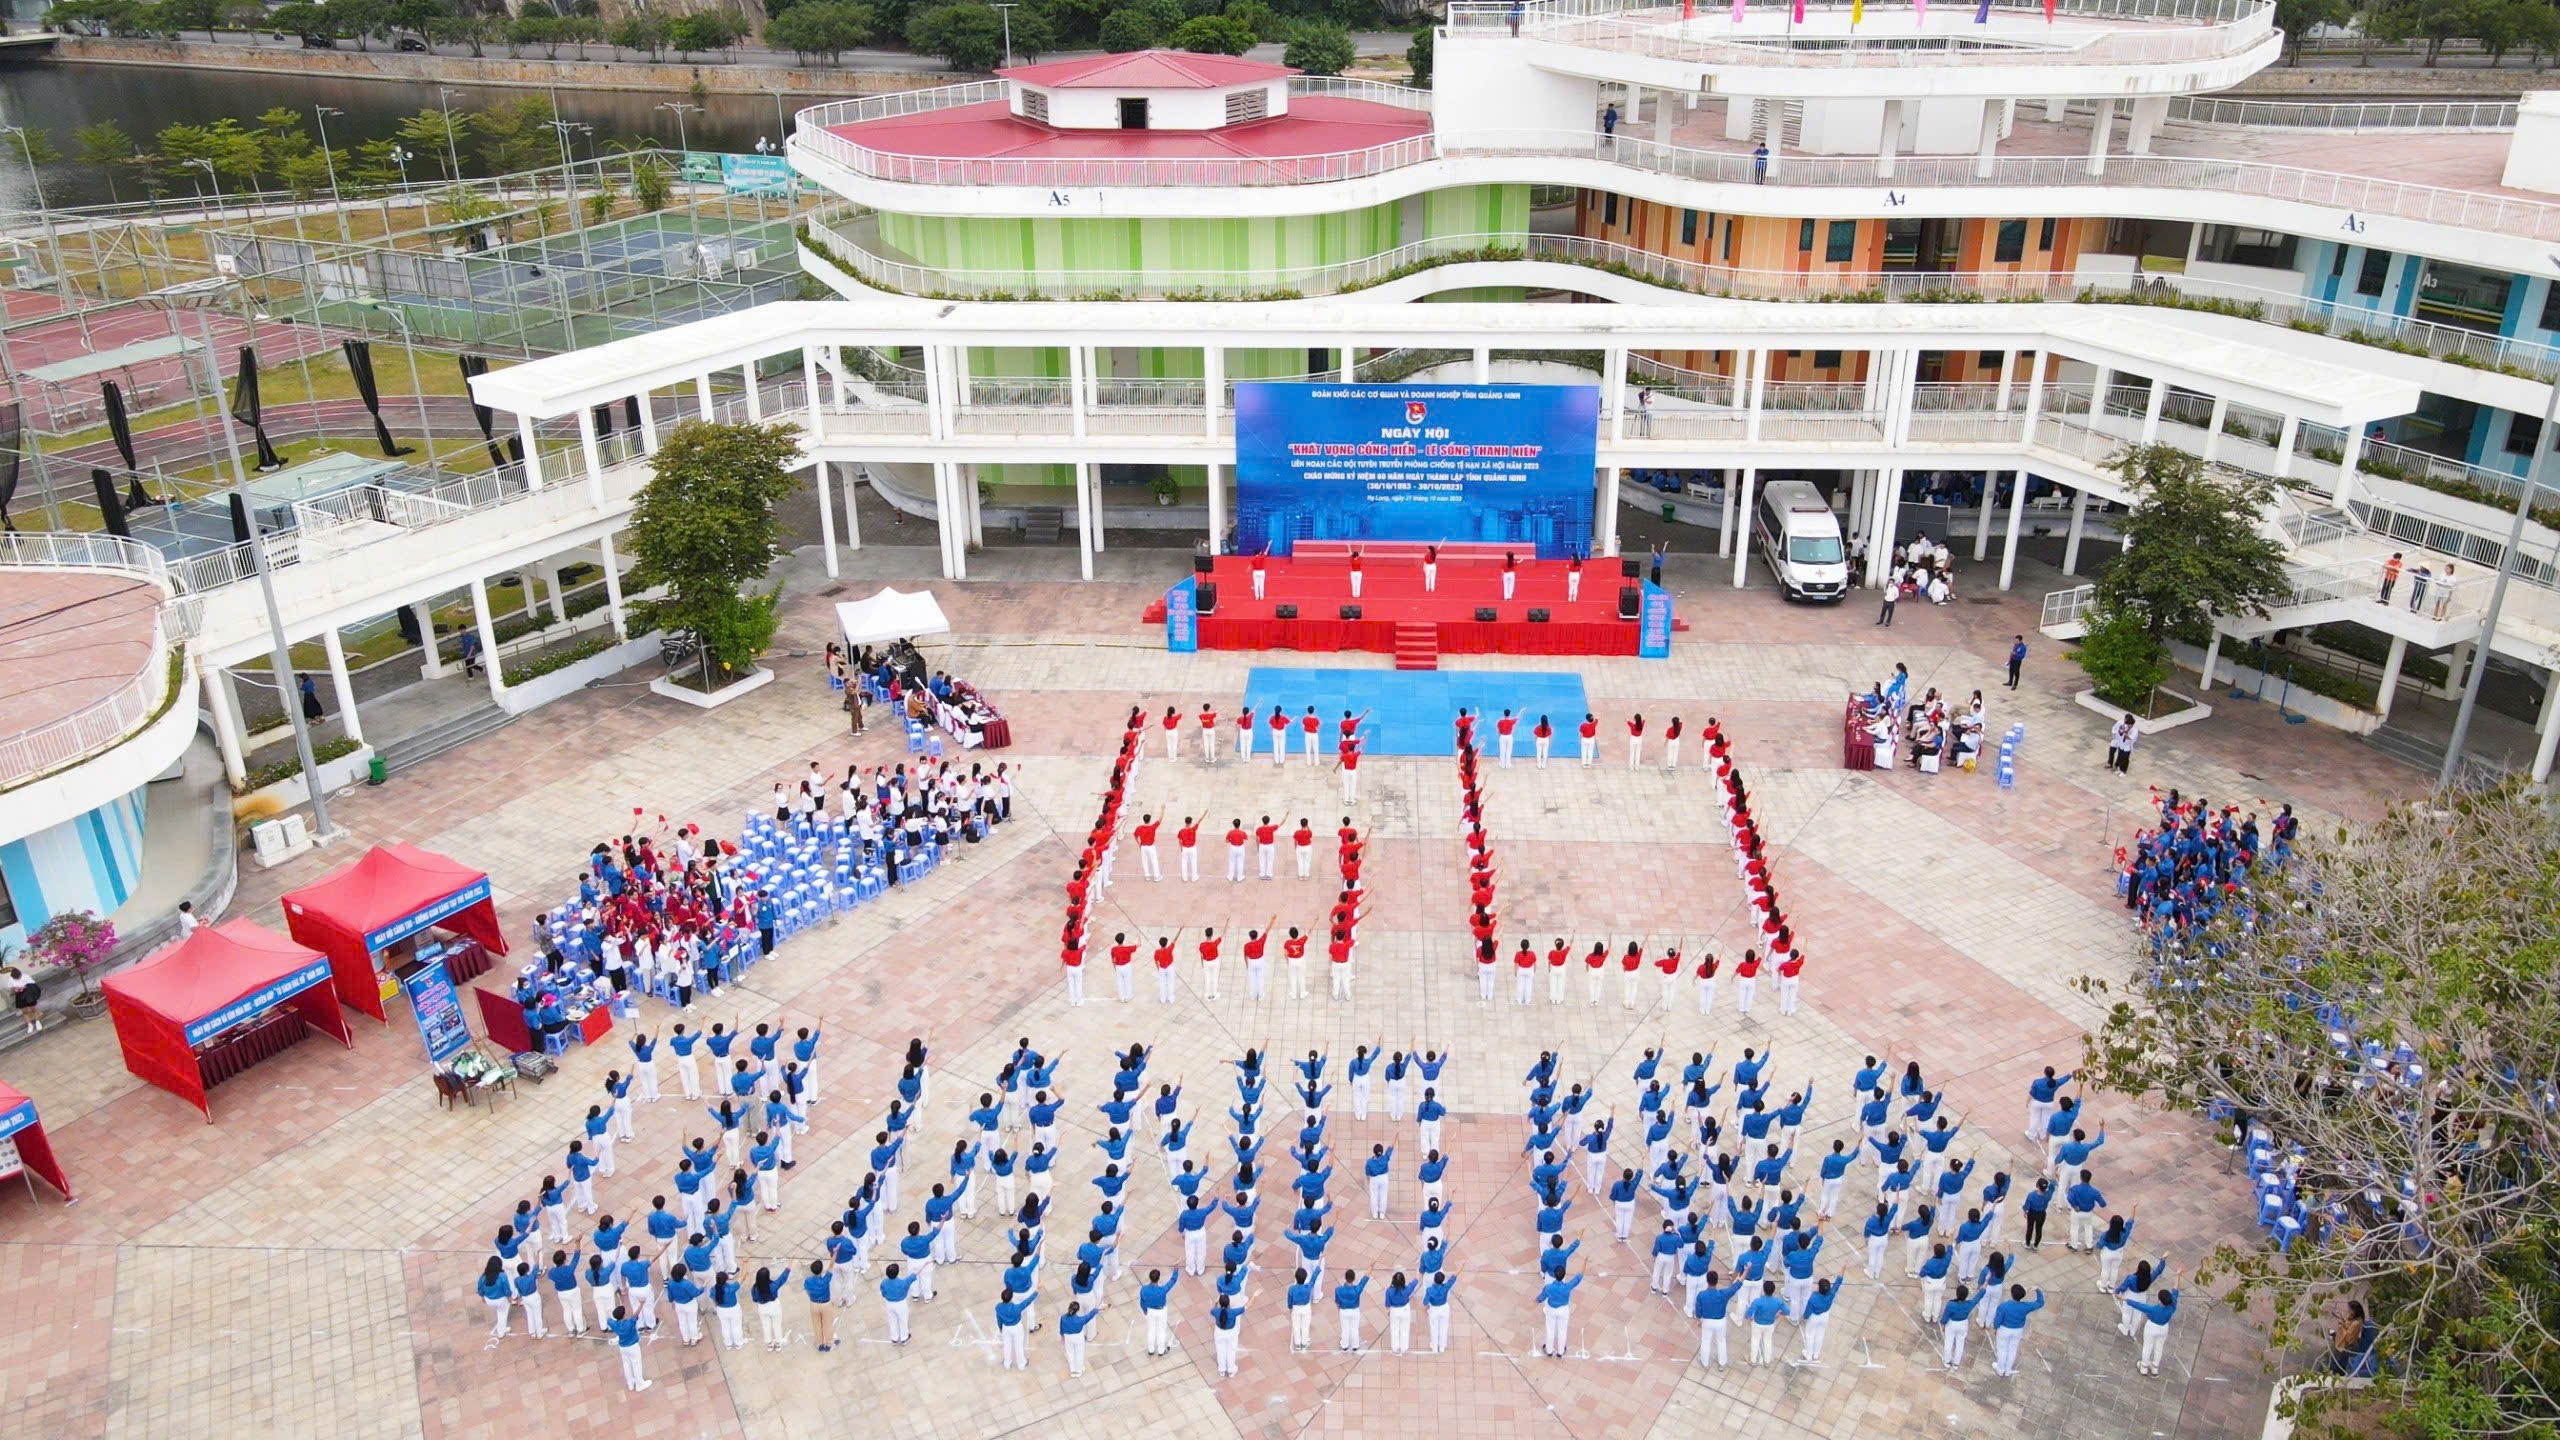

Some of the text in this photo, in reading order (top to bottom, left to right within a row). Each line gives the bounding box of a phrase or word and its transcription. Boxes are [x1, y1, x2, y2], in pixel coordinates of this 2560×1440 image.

[1048, 190, 1070, 206] A5
[1883, 189, 1905, 206] A4
[2340, 213, 2365, 234] A3
[2421, 273, 2438, 288] A3
[1351, 389, 1366, 398] CÁC
[1367, 390, 1379, 398] CƠ
[1380, 391, 1399, 399] QUAN
[1399, 389, 1410, 398] VÀ
[1411, 391, 1435, 399] DOANH
[1436, 389, 1461, 401] NGHIỆP
[1504, 392, 1521, 400] NINH
[1381, 426, 1450, 440] NGÀY HỘI
[1324, 443, 1355, 457] VỌNG
[1357, 441, 1388, 456] CỐNG
[1390, 441, 1417, 456] HIẾN
[1439, 441, 1471, 457] SỐNG
[1472, 444, 1510, 457] THANH
[1291, 459, 1304, 468] LIÊN
[1327, 459, 1342, 468] CÁC
[1343, 460, 1356, 469] ĐỘI
[1379, 458, 1403, 468] TRUYỀN
[1404, 460, 1428, 469] PHÒNG
[1429, 459, 1455, 469] CHỐNG
[1465, 462, 1480, 471] NẠN
[1481, 460, 1491, 469] XÃ
[1492, 461, 1504, 471] HỘI
[1506, 461, 1522, 470] NĂM
[1450, 472, 1464, 482] LẬP
